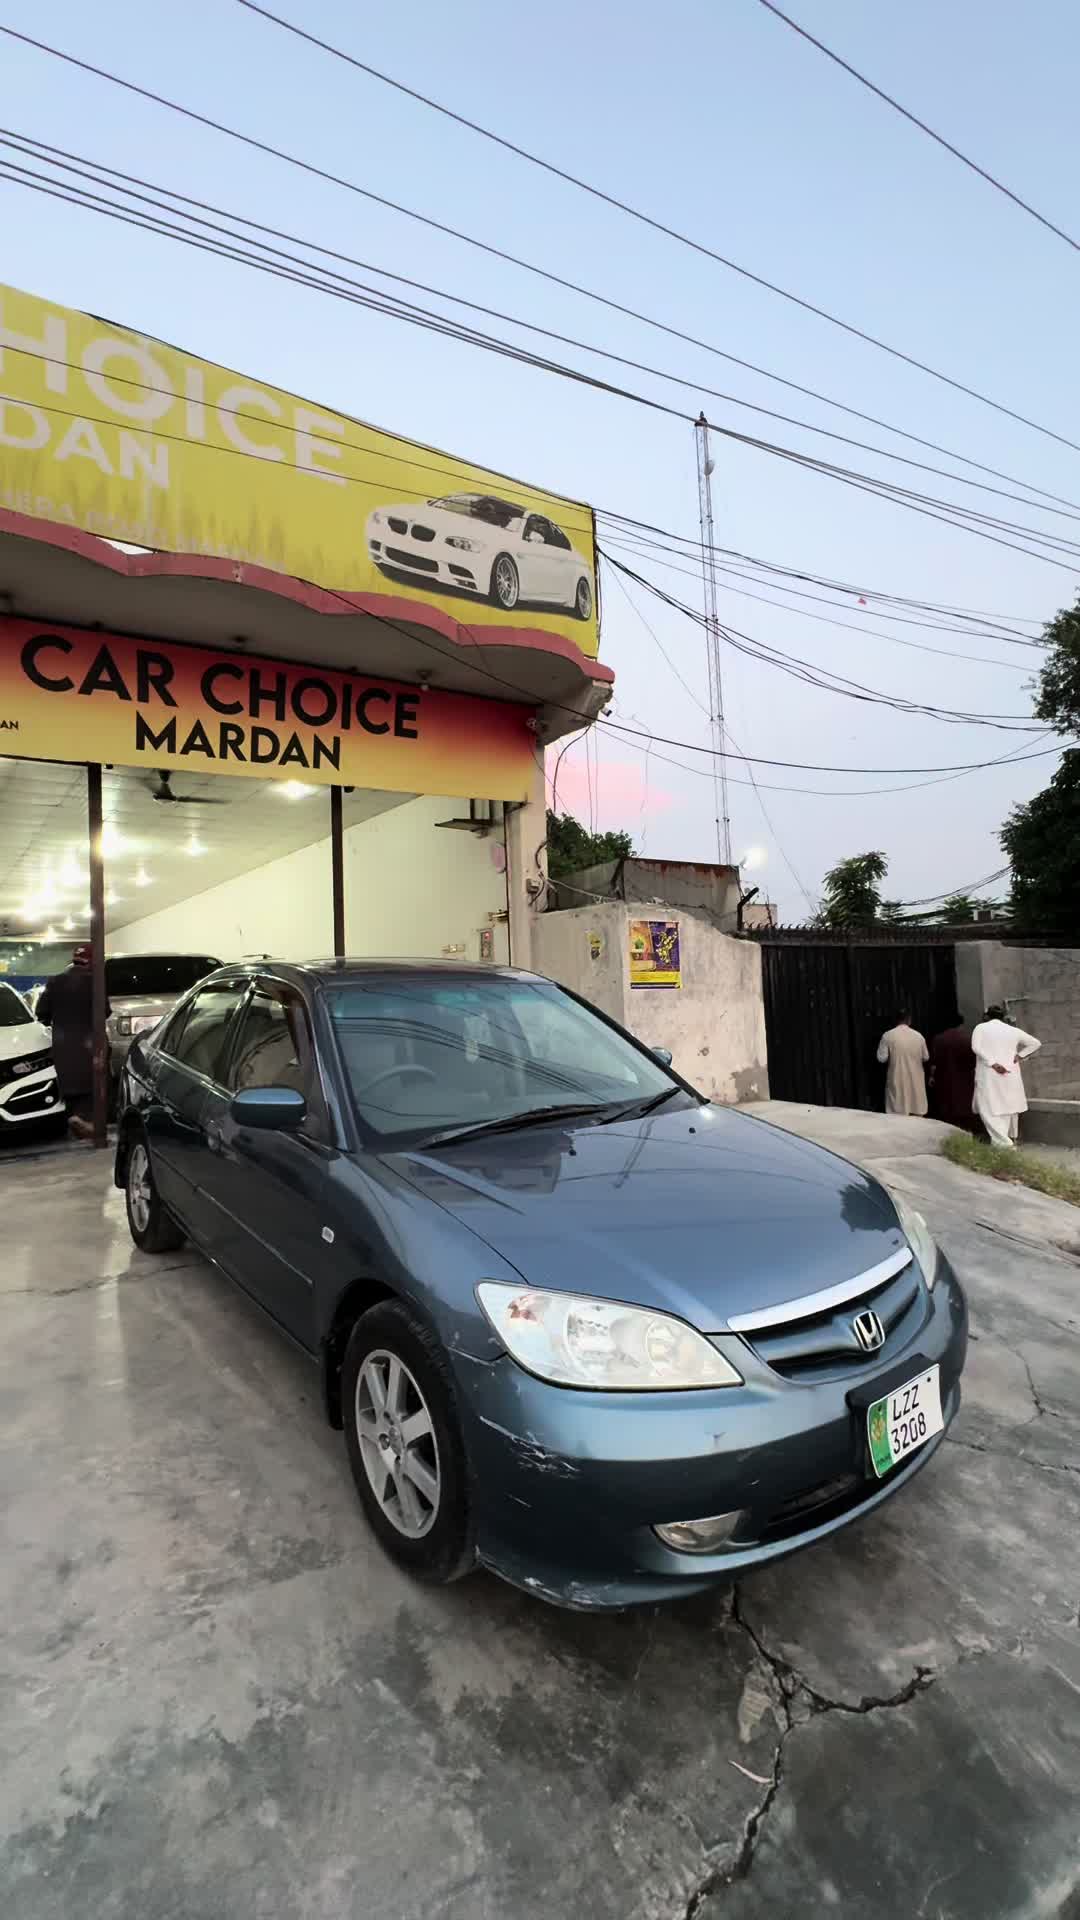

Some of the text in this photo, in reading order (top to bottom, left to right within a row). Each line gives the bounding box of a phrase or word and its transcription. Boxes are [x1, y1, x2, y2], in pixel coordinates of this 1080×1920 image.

[20, 634, 421, 739] CAR CHOICE
[135, 710, 341, 771] MARDAN
[892, 1383, 920, 1421] LZZ
[890, 1411, 927, 1454] 3208
